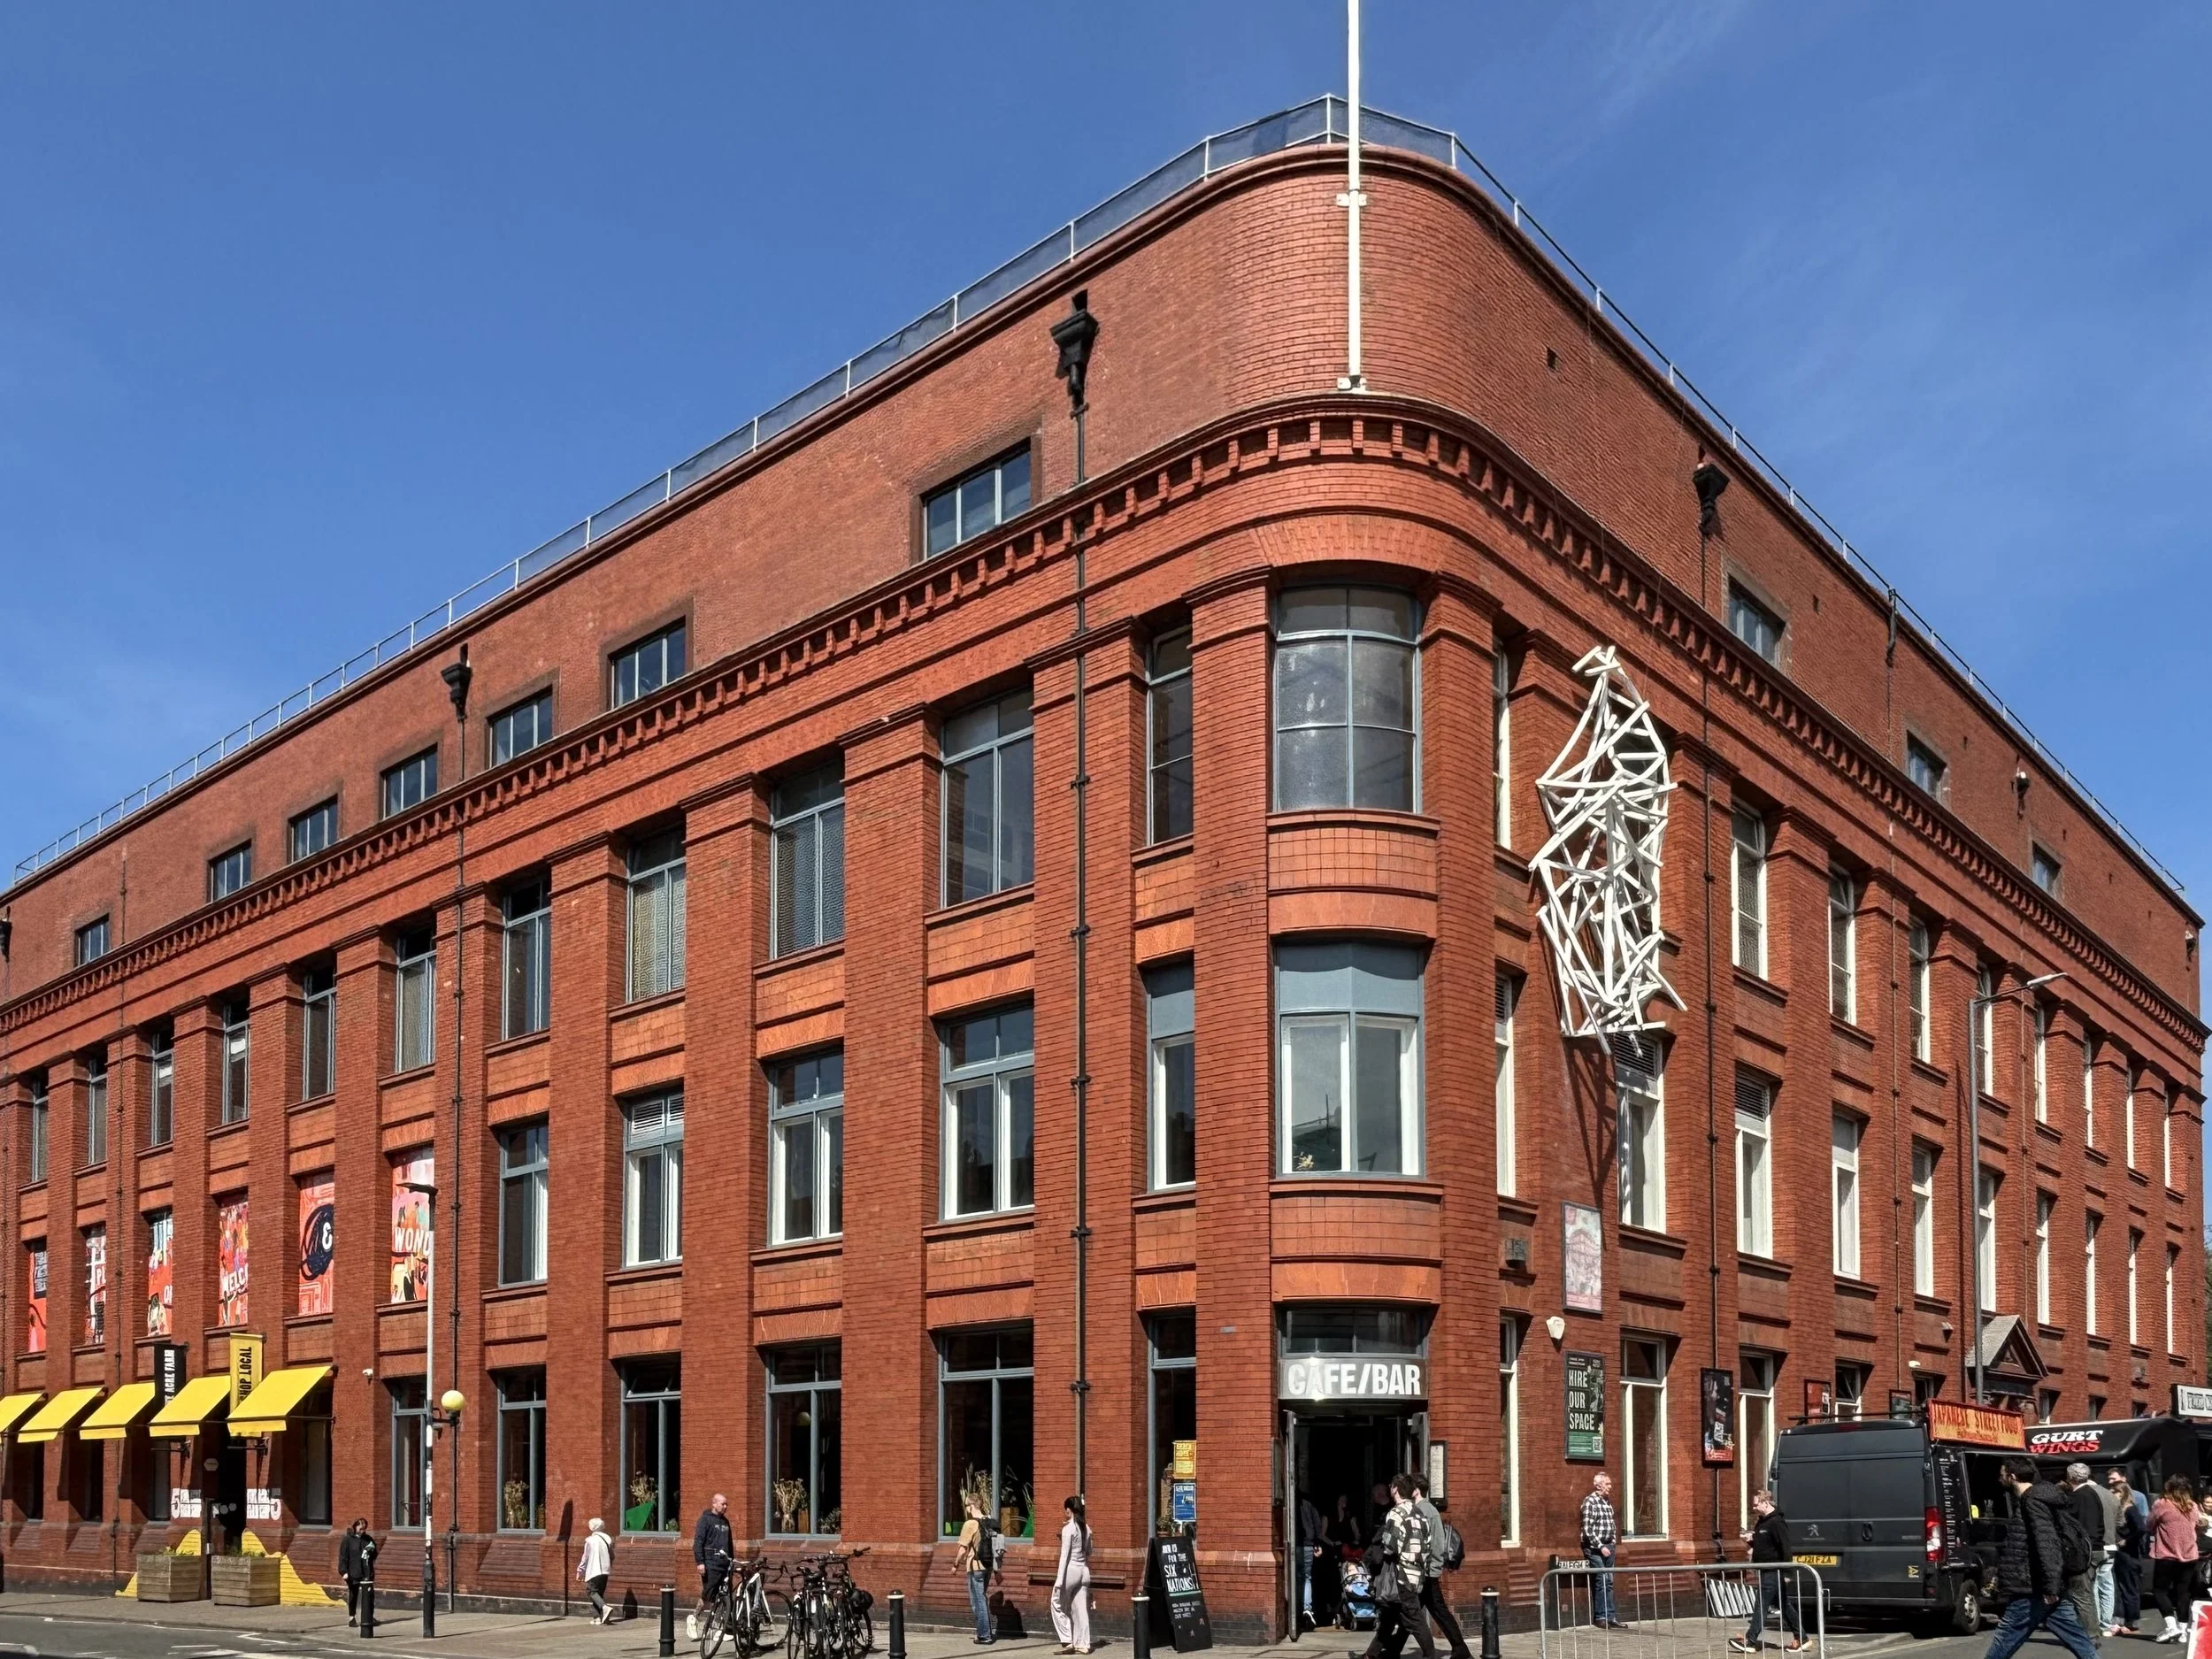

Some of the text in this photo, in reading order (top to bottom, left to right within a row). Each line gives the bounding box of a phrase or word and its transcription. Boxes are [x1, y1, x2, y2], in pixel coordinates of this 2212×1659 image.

[239, 1347, 252, 1375] LOCAL
[1287, 1363, 1421, 1395] CAFE/BAR
[1568, 1369, 1588, 1387] HIRE
[1569, 1391, 1586, 1409] OUR
[1569, 1412, 1594, 1431] SPACE
[2032, 1430, 2104, 1444] GURT
[2029, 1440, 2100, 1454] WINGS
[1164, 1564, 1178, 1578] SIX
